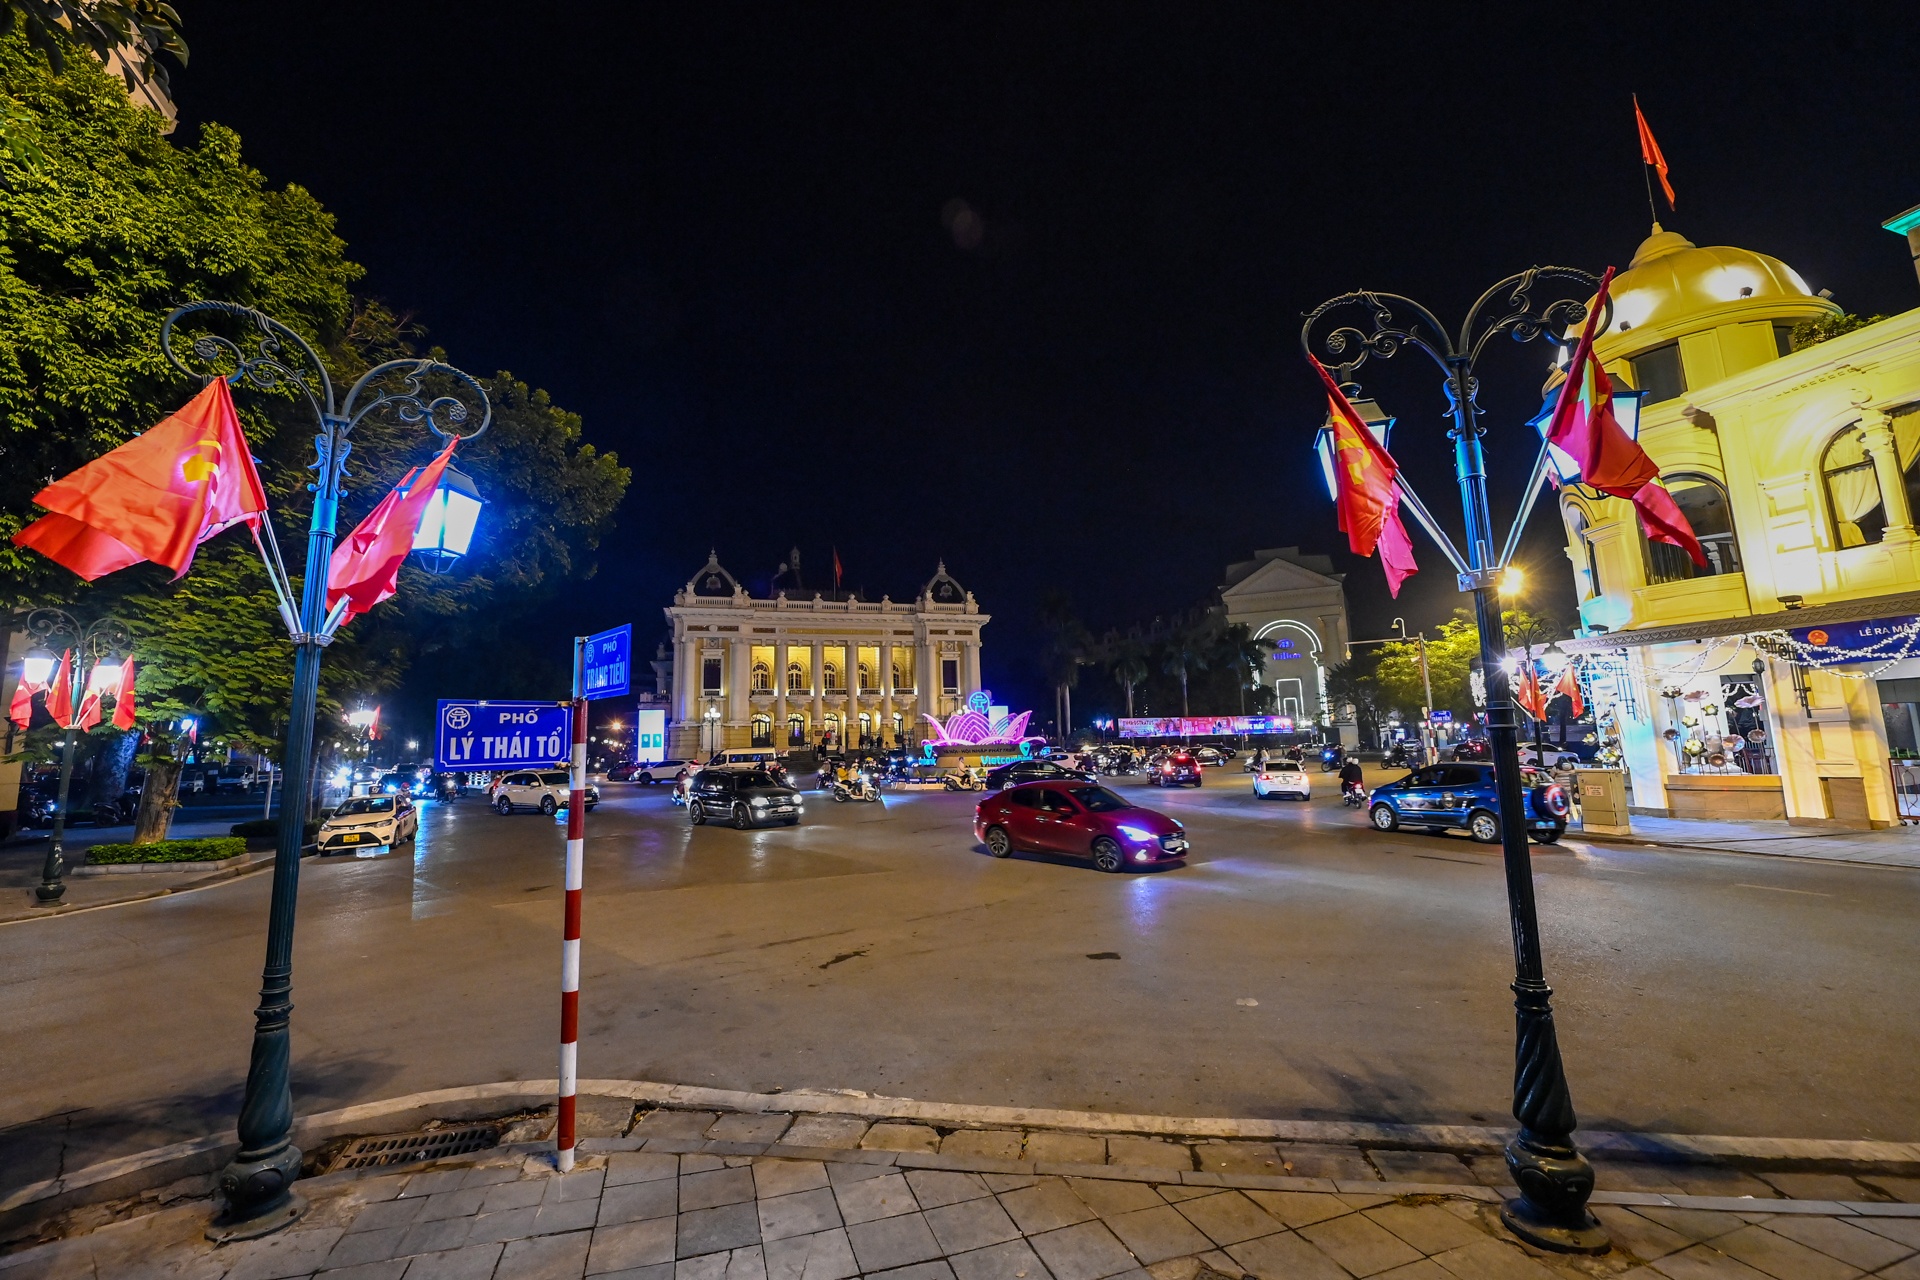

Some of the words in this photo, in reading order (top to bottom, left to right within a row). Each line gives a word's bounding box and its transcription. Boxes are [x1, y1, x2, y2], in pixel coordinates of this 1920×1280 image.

[1874, 627, 1890, 635] RA
[603, 635, 617, 654] PHỐ
[1272, 651, 1302, 660] Hilton
[586, 661, 609, 690] TRÀNG
[609, 654, 625, 686] TIỀN
[499, 708, 540, 724] PHỐ
[449, 730, 475, 760] LÝ
[481, 730, 530, 759] THÁI
[536, 726, 562, 758] TỔ
